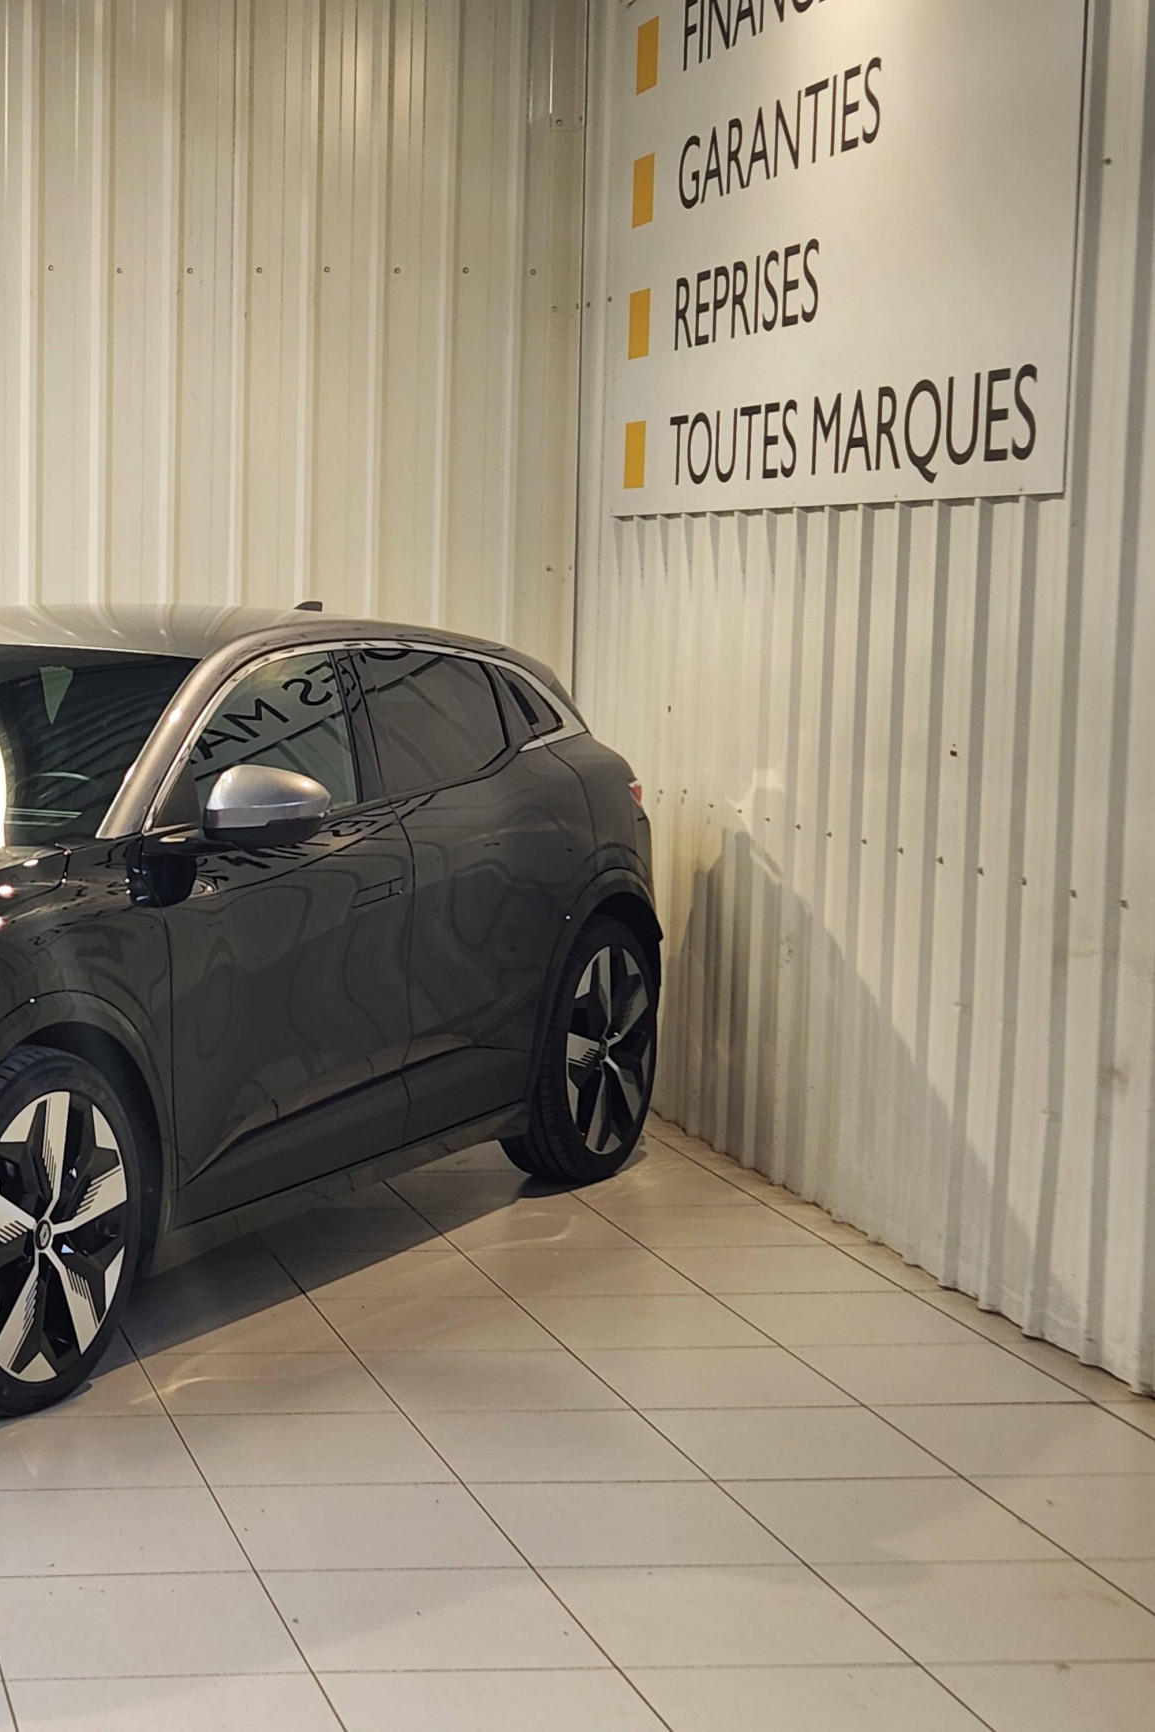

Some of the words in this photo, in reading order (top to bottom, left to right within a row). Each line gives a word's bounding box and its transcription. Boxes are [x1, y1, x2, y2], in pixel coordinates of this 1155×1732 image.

[683, 0, 827, 71] FINA
[679, 57, 881, 209] GARANTIES
[675, 239, 819, 350] REPRISES
[670, 400, 797, 485] TOUTES
[812, 364, 1037, 483] MARQUES
